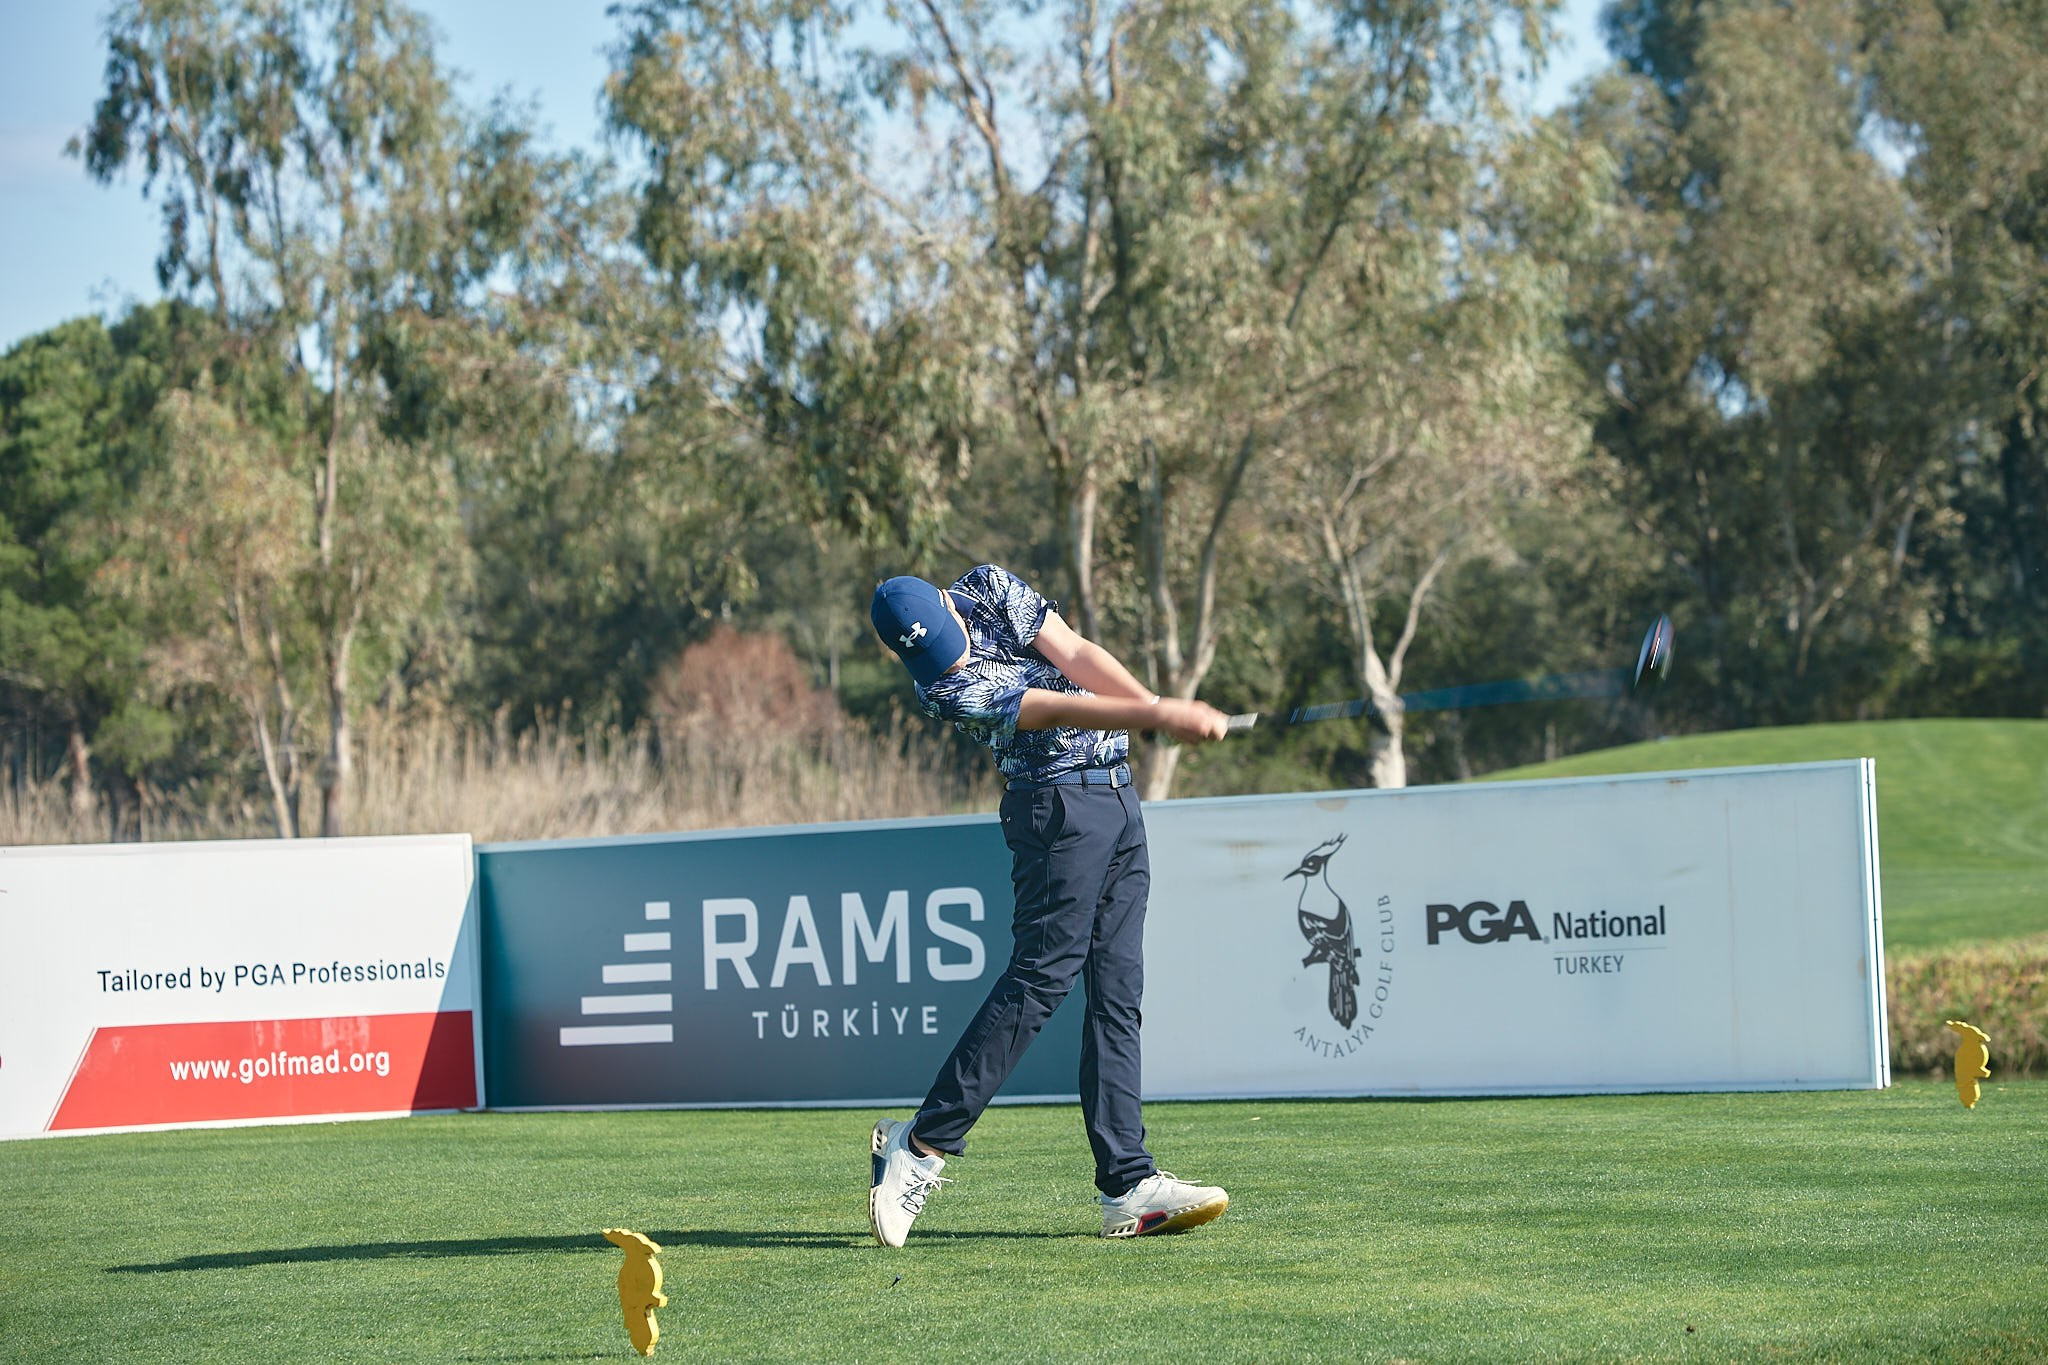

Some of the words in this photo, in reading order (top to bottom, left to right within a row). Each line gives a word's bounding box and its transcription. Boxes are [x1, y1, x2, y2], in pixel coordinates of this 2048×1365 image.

[702, 887, 986, 990] RAMS
[1377, 895, 1396, 954] CLUB
[1425, 900, 1542, 945] PGA
[1553, 905, 1666, 939] National
[97, 967, 191, 993] Tailored
[200, 966, 226, 993] by
[235, 963, 286, 987] PGA
[292, 957, 446, 985] Professionals
[1553, 955, 1624, 975] TURKEY
[1369, 960, 1395, 1019] GOLF
[752, 1001, 938, 1039] TÜRKİYE
[1293, 1023, 1375, 1059] ANTALYA
[169, 1048, 390, 1084] www.golfmad.org
